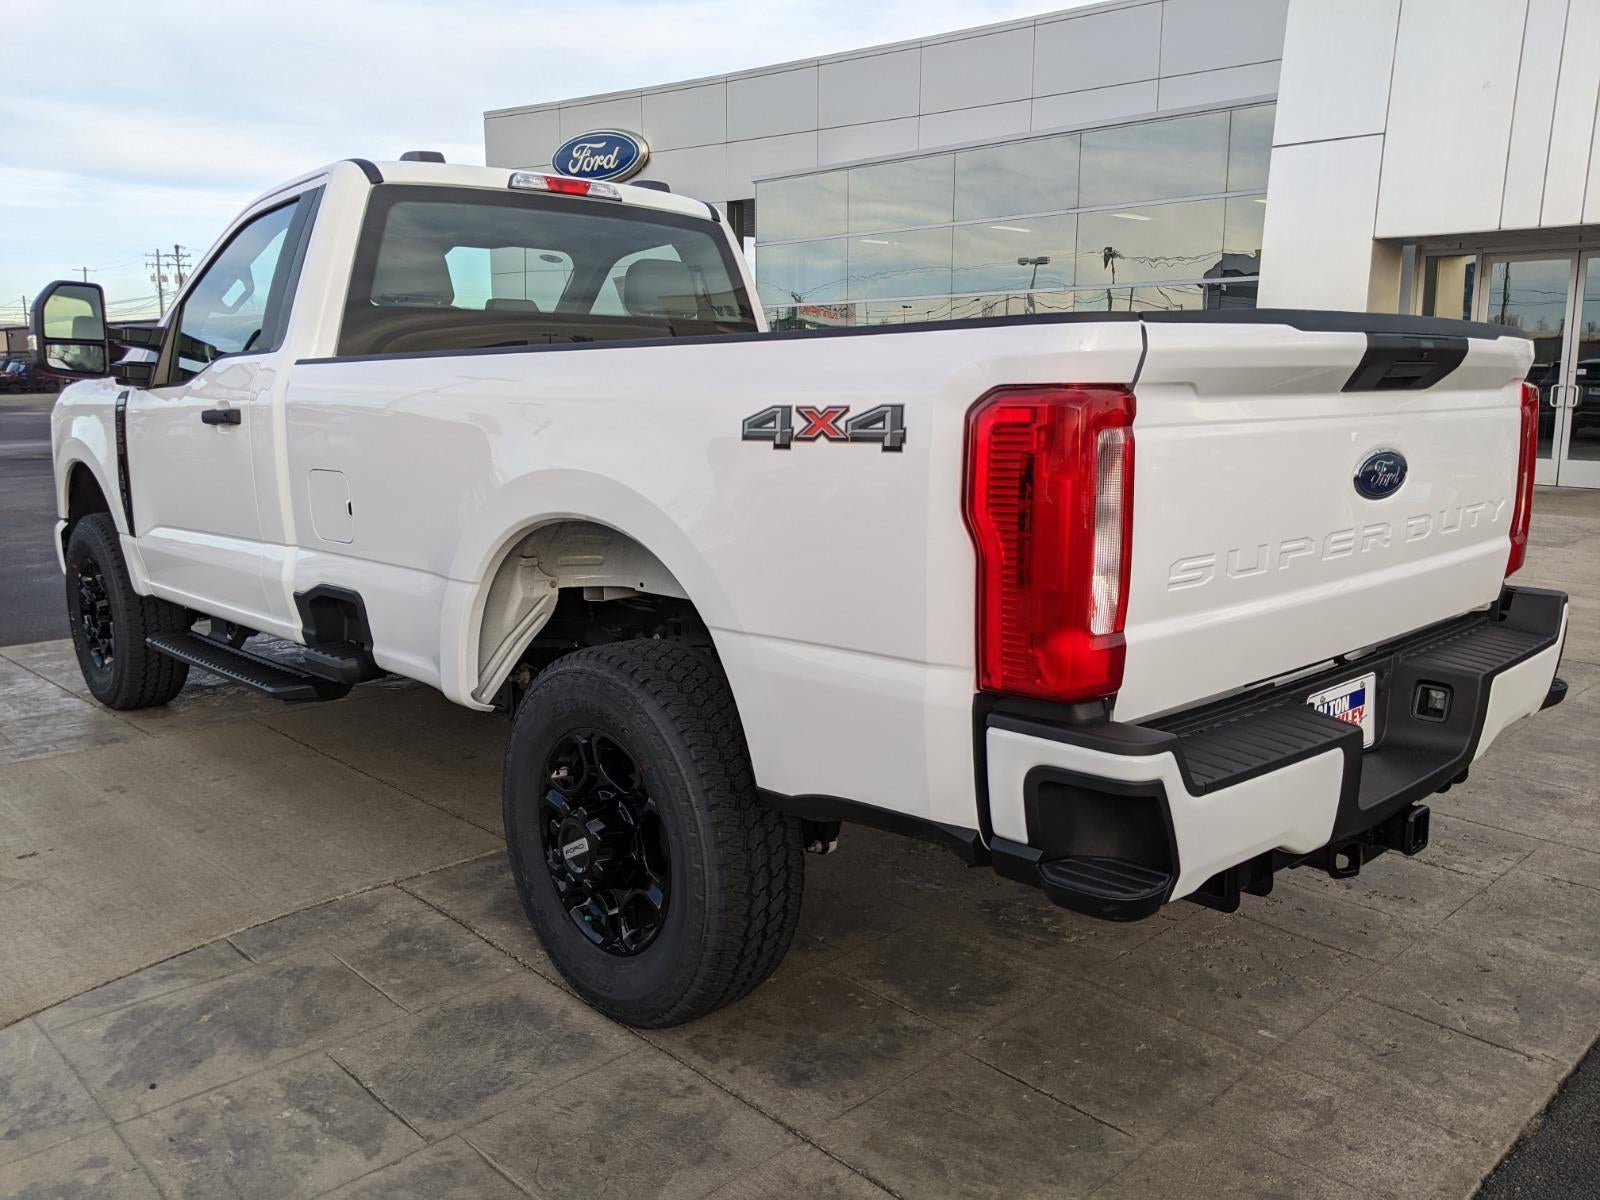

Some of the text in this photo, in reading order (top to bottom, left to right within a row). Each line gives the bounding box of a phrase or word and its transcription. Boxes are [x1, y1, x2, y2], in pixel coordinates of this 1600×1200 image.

[568, 141, 619, 174] Ford
[1370, 459, 1401, 488] Ford
[1167, 497, 1506, 592] SUPER DUTY
[565, 844, 584, 854] FORD
